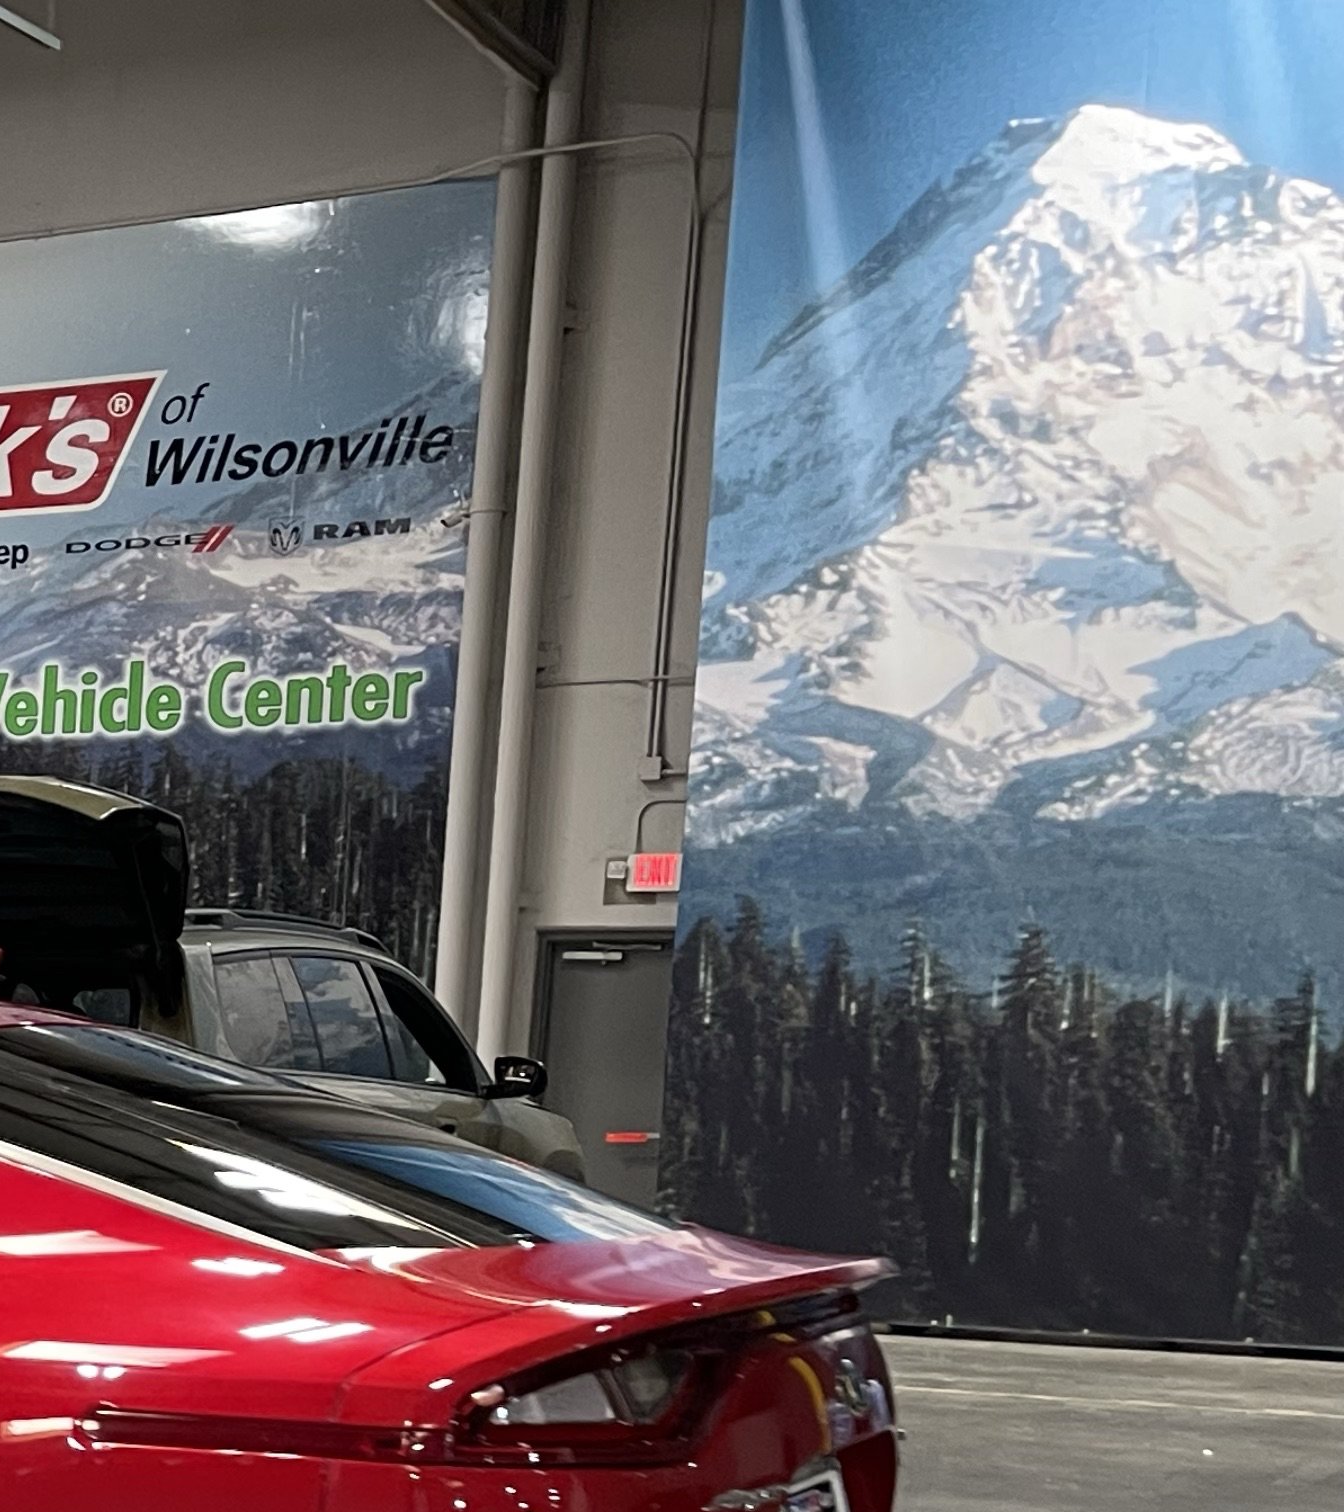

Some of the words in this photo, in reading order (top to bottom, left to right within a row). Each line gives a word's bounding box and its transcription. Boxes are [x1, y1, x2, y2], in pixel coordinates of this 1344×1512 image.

[161, 382, 210, 425] of
[145, 414, 455, 487] Wilsonville
[65, 533, 208, 554] DODGE
[313, 517, 412, 540] RAM
[209, 661, 423, 729] Center
